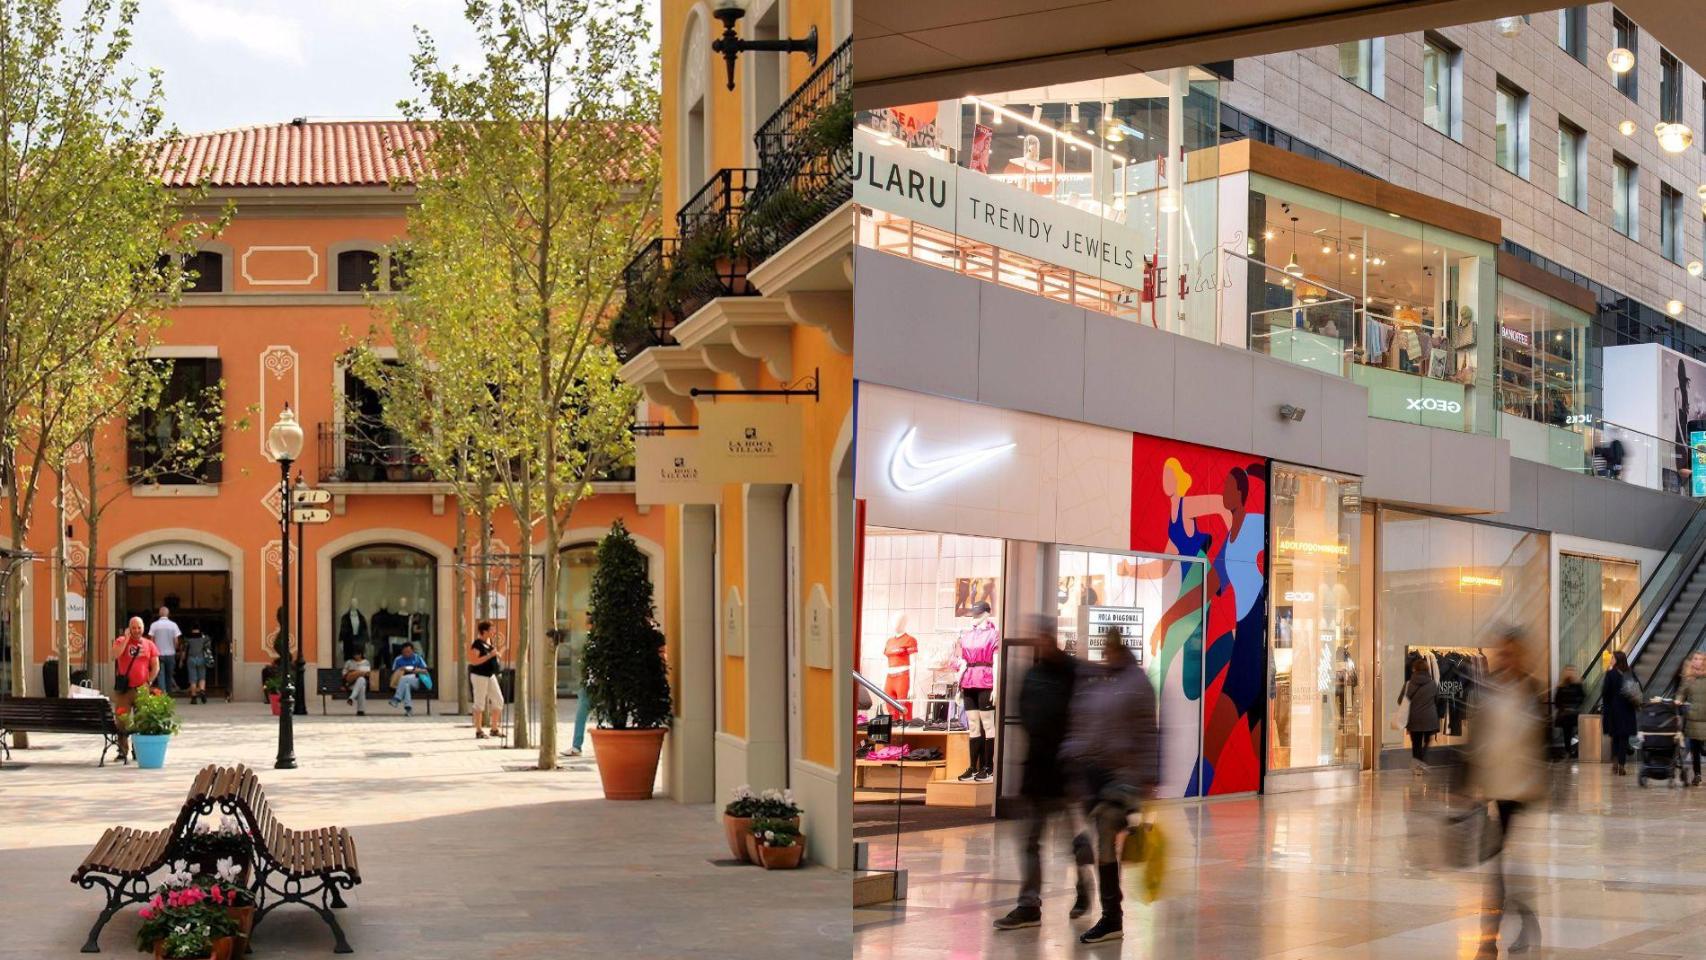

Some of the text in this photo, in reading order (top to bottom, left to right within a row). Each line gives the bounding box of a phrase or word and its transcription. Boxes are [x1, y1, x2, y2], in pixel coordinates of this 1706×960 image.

[969, 197, 1053, 243] TRENDY
[1062, 230, 1133, 270] JEWELS
[150, 553, 203, 567] MaxMara
[1438, 681, 1463, 693] NSPIRA
